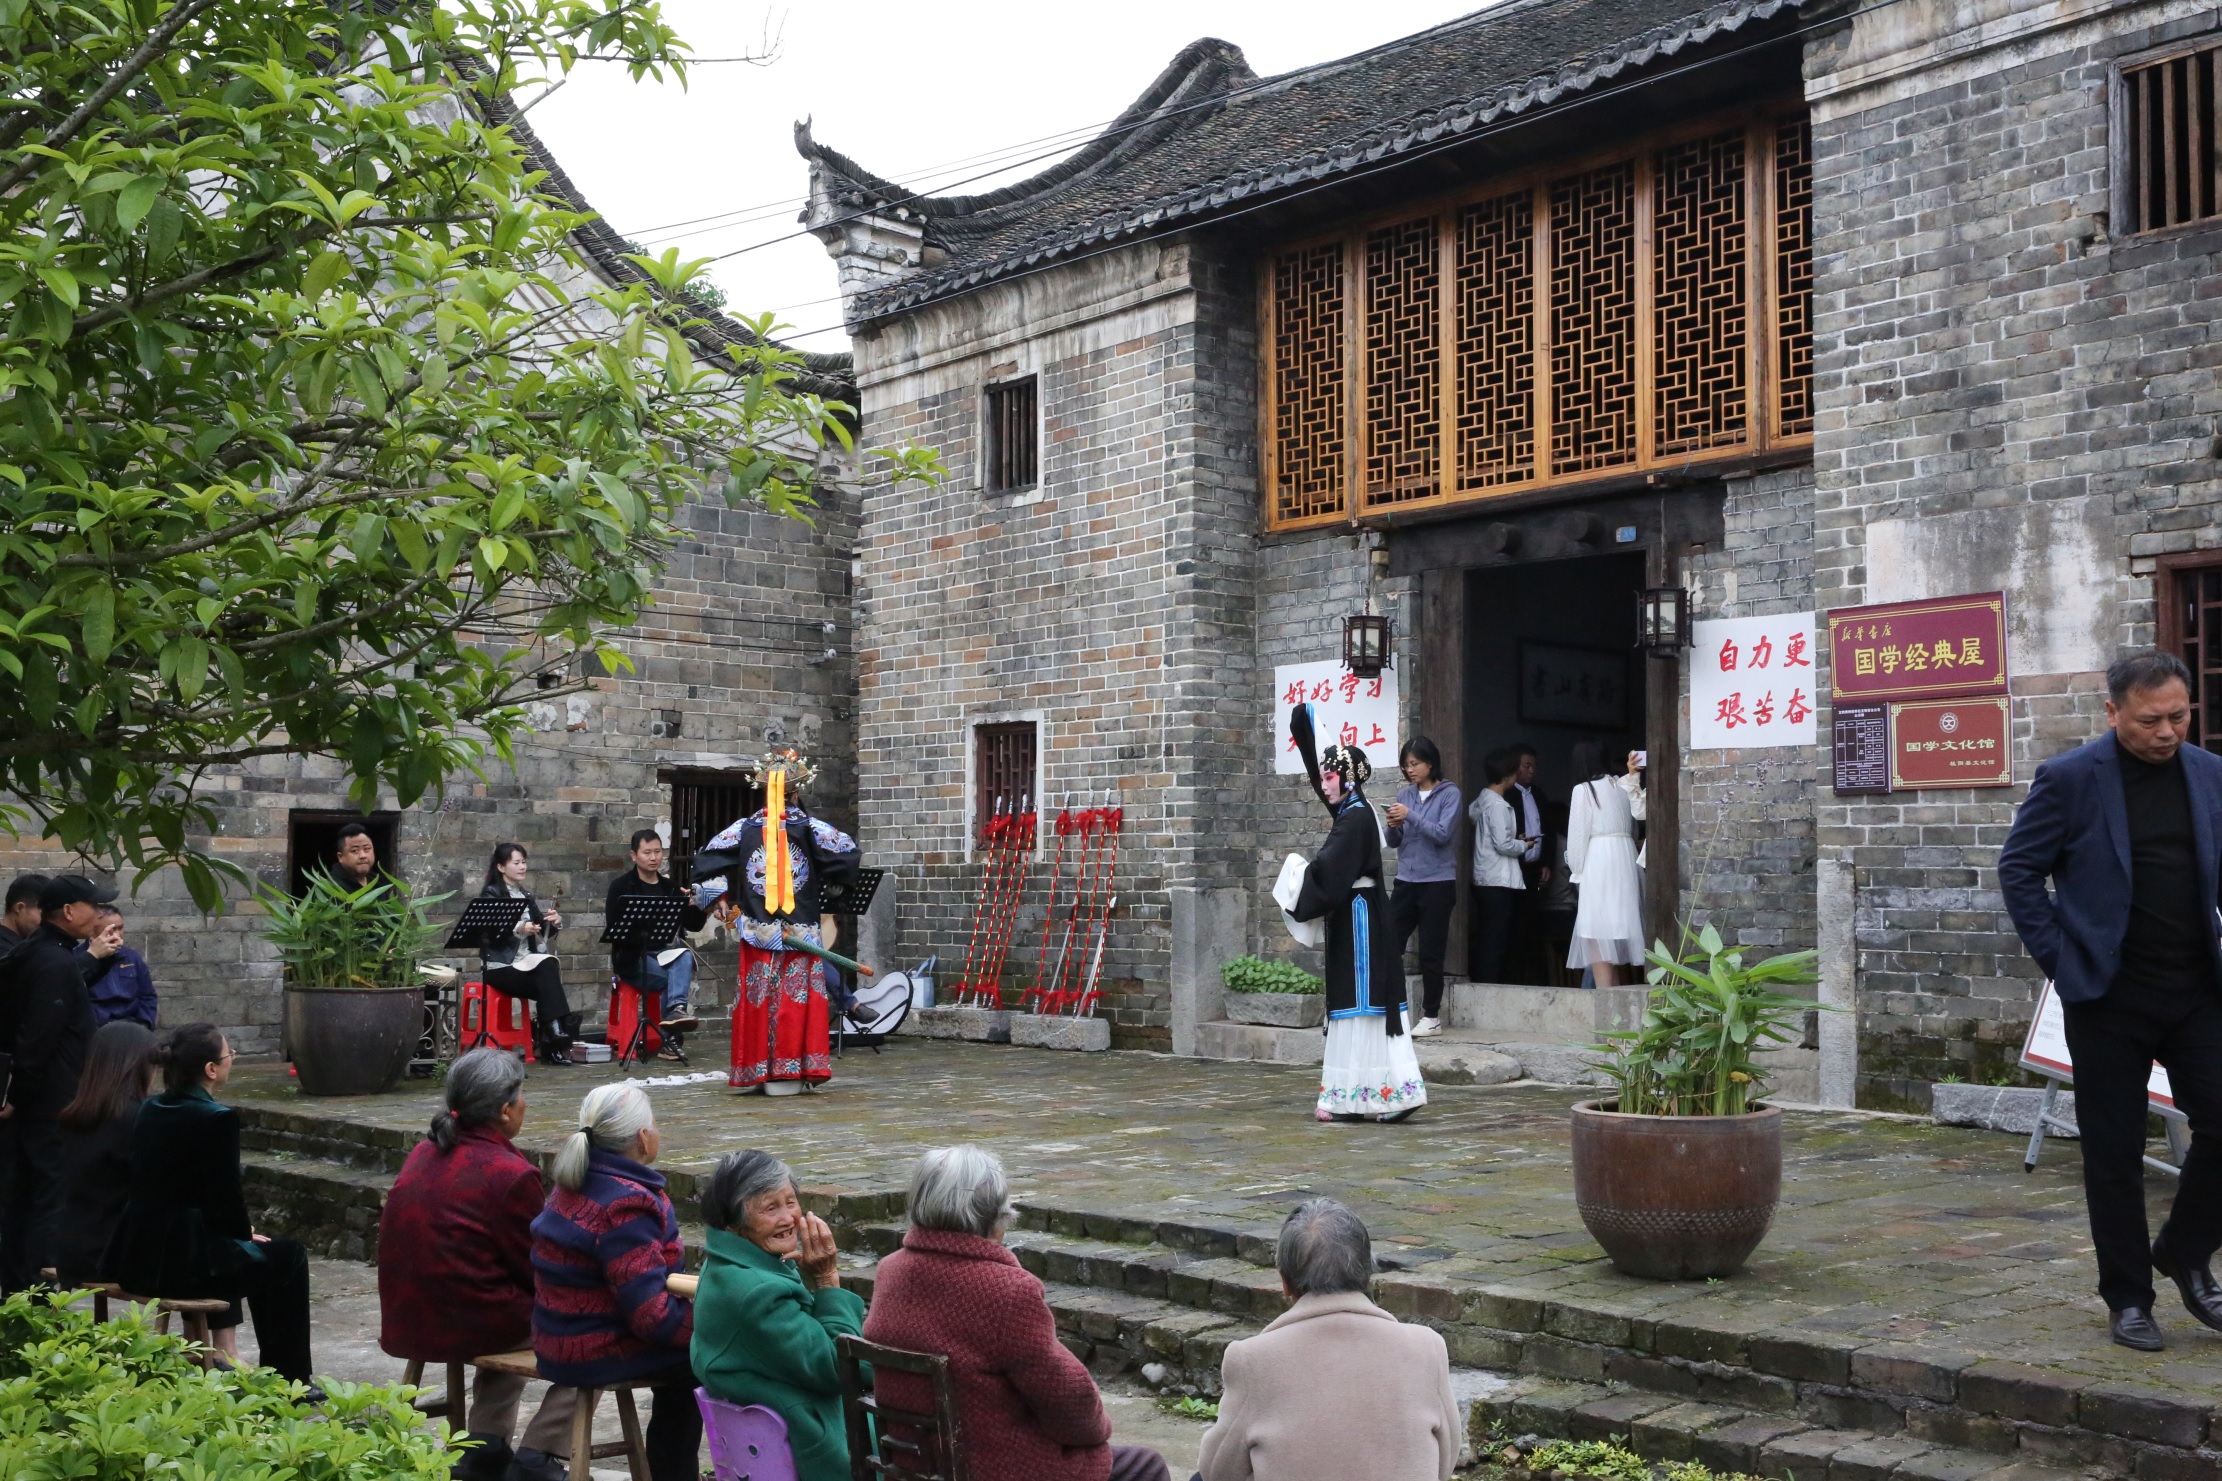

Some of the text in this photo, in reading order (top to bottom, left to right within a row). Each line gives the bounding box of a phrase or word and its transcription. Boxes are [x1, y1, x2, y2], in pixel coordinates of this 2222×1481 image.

[1719, 632, 1811, 672] 自力更
[1855, 638, 1985, 675] 国学经典屋
[1283, 673, 1383, 704] 好好学习
[1714, 687, 1813, 729] 艰苦奋
[1906, 738, 1995, 752] 国学文化馆
